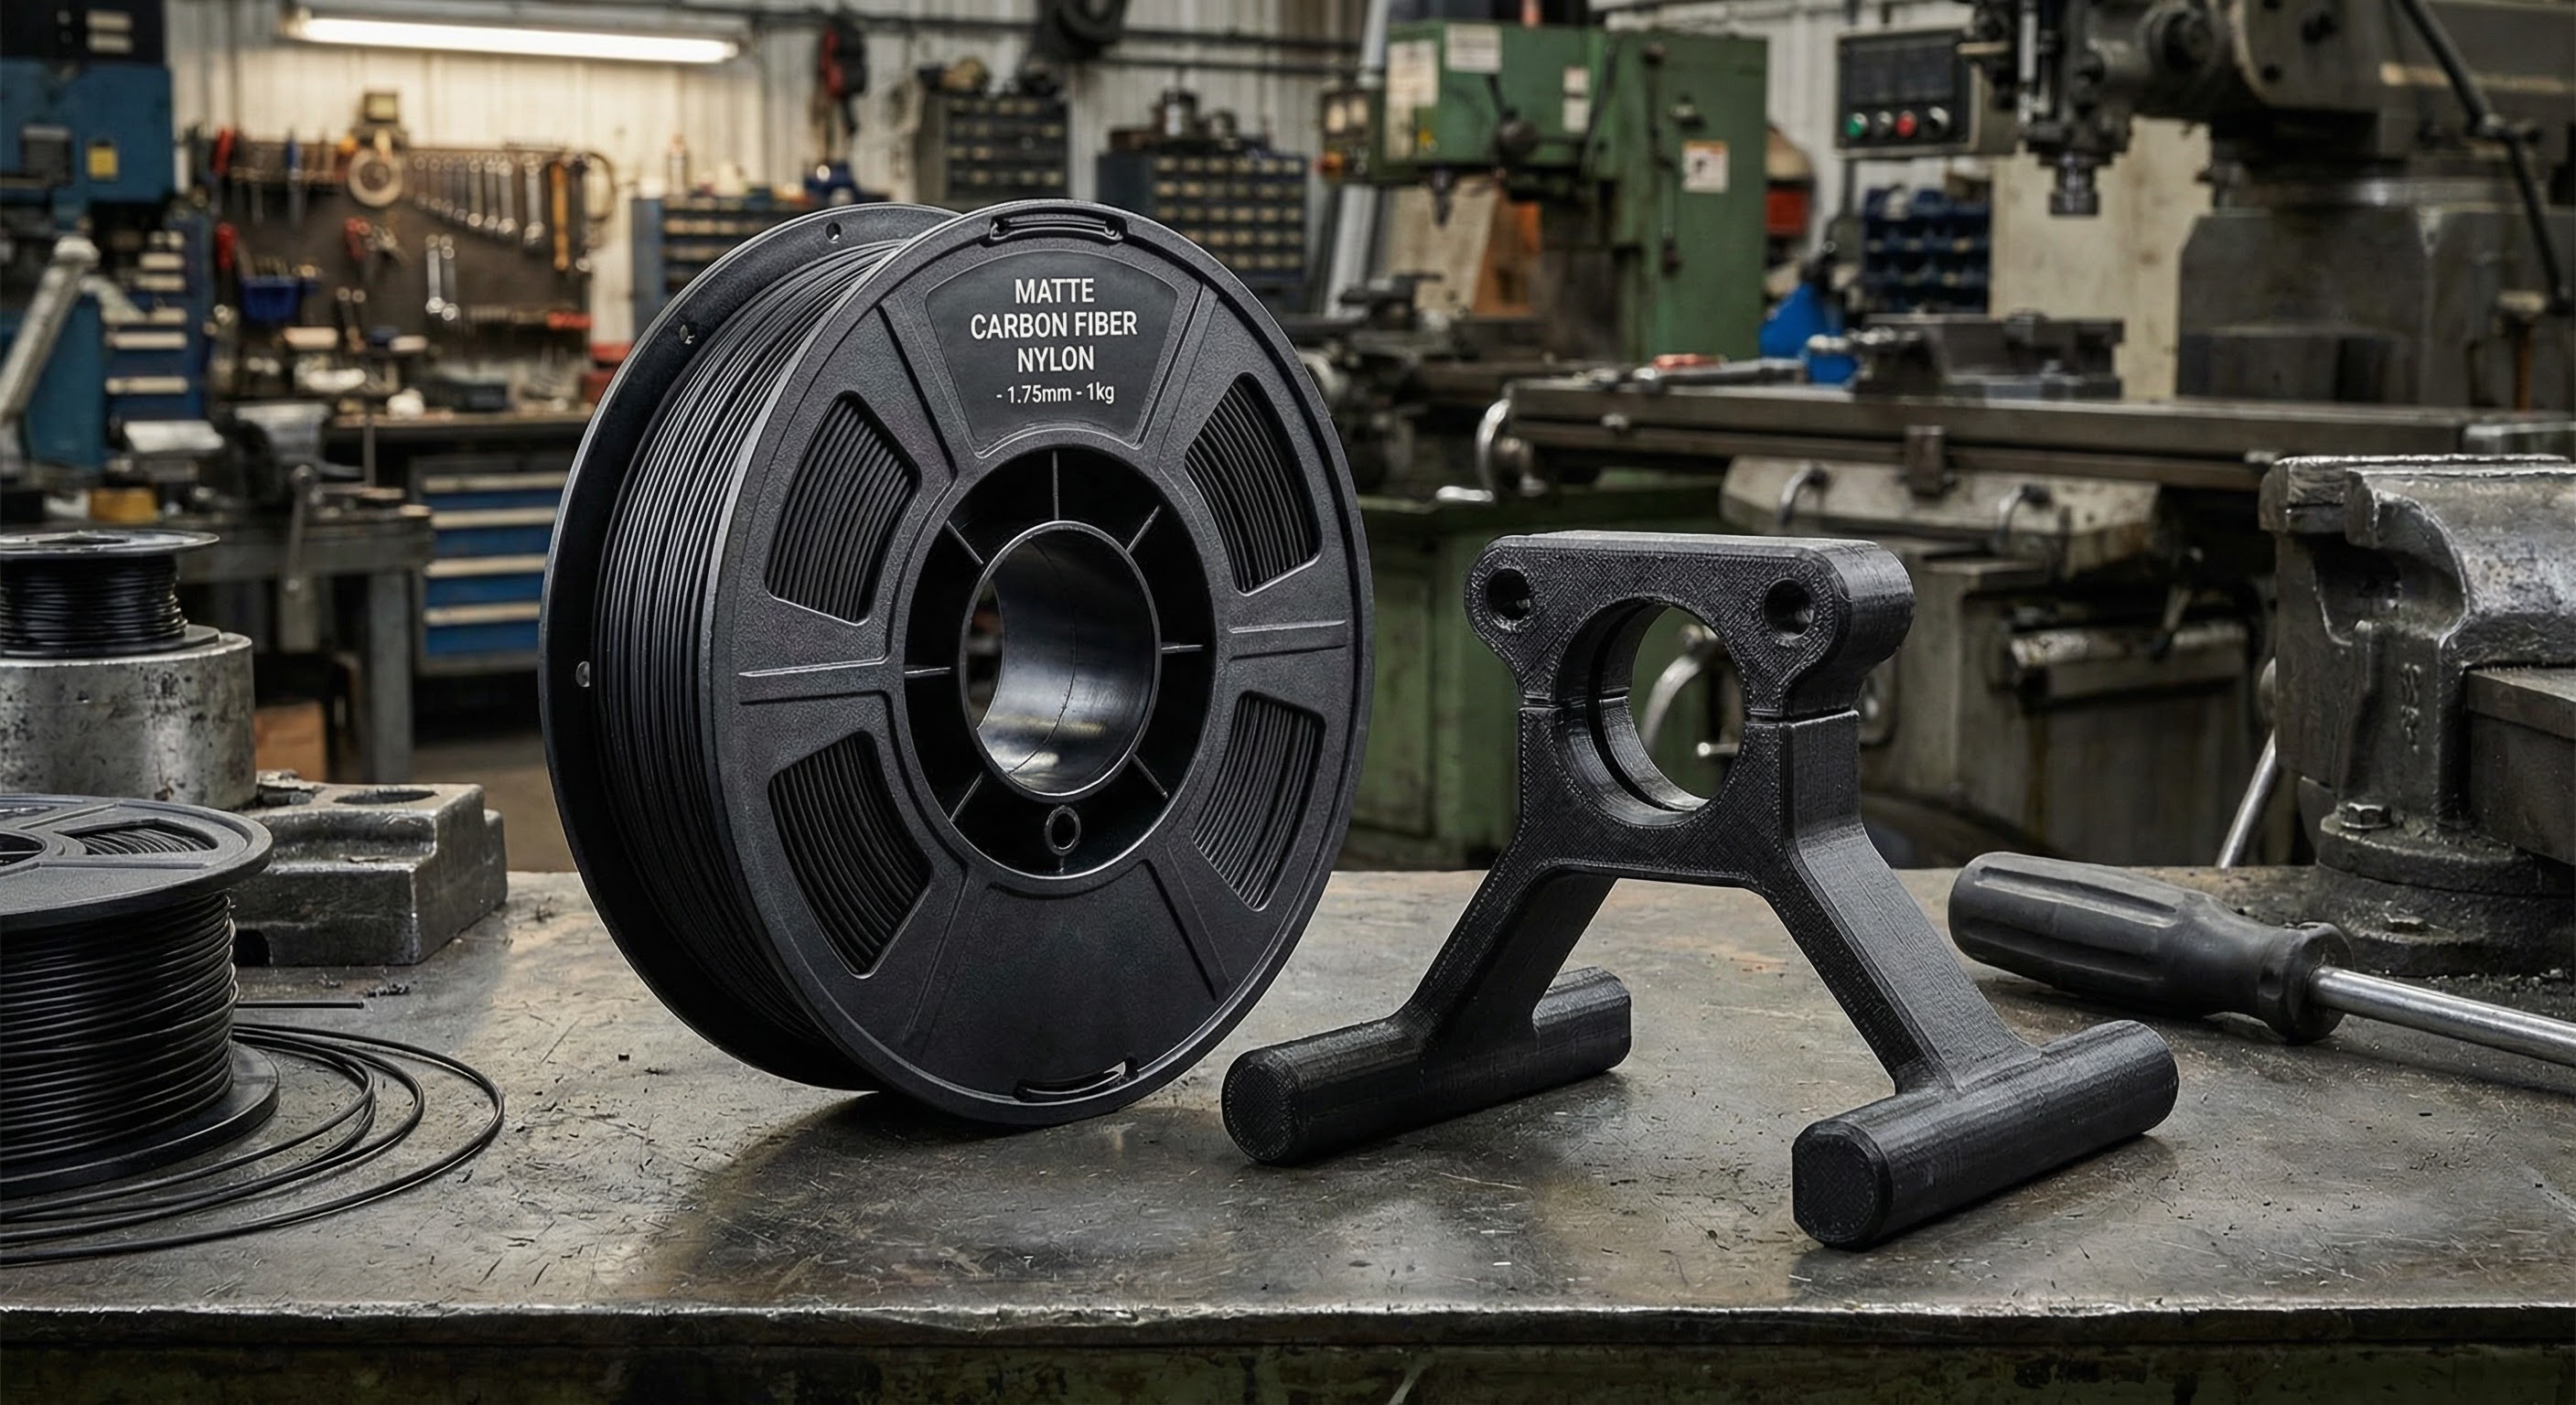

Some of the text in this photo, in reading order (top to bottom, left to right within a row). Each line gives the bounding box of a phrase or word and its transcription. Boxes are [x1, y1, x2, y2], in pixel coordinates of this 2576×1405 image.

[1014, 277, 1095, 305] MATTE
[970, 310, 1138, 340] CARBON FIBER
[1017, 345, 1094, 373] NYLON
[1007, 384, 1072, 404] 1.75mm
[1086, 381, 1114, 404] 1kg
